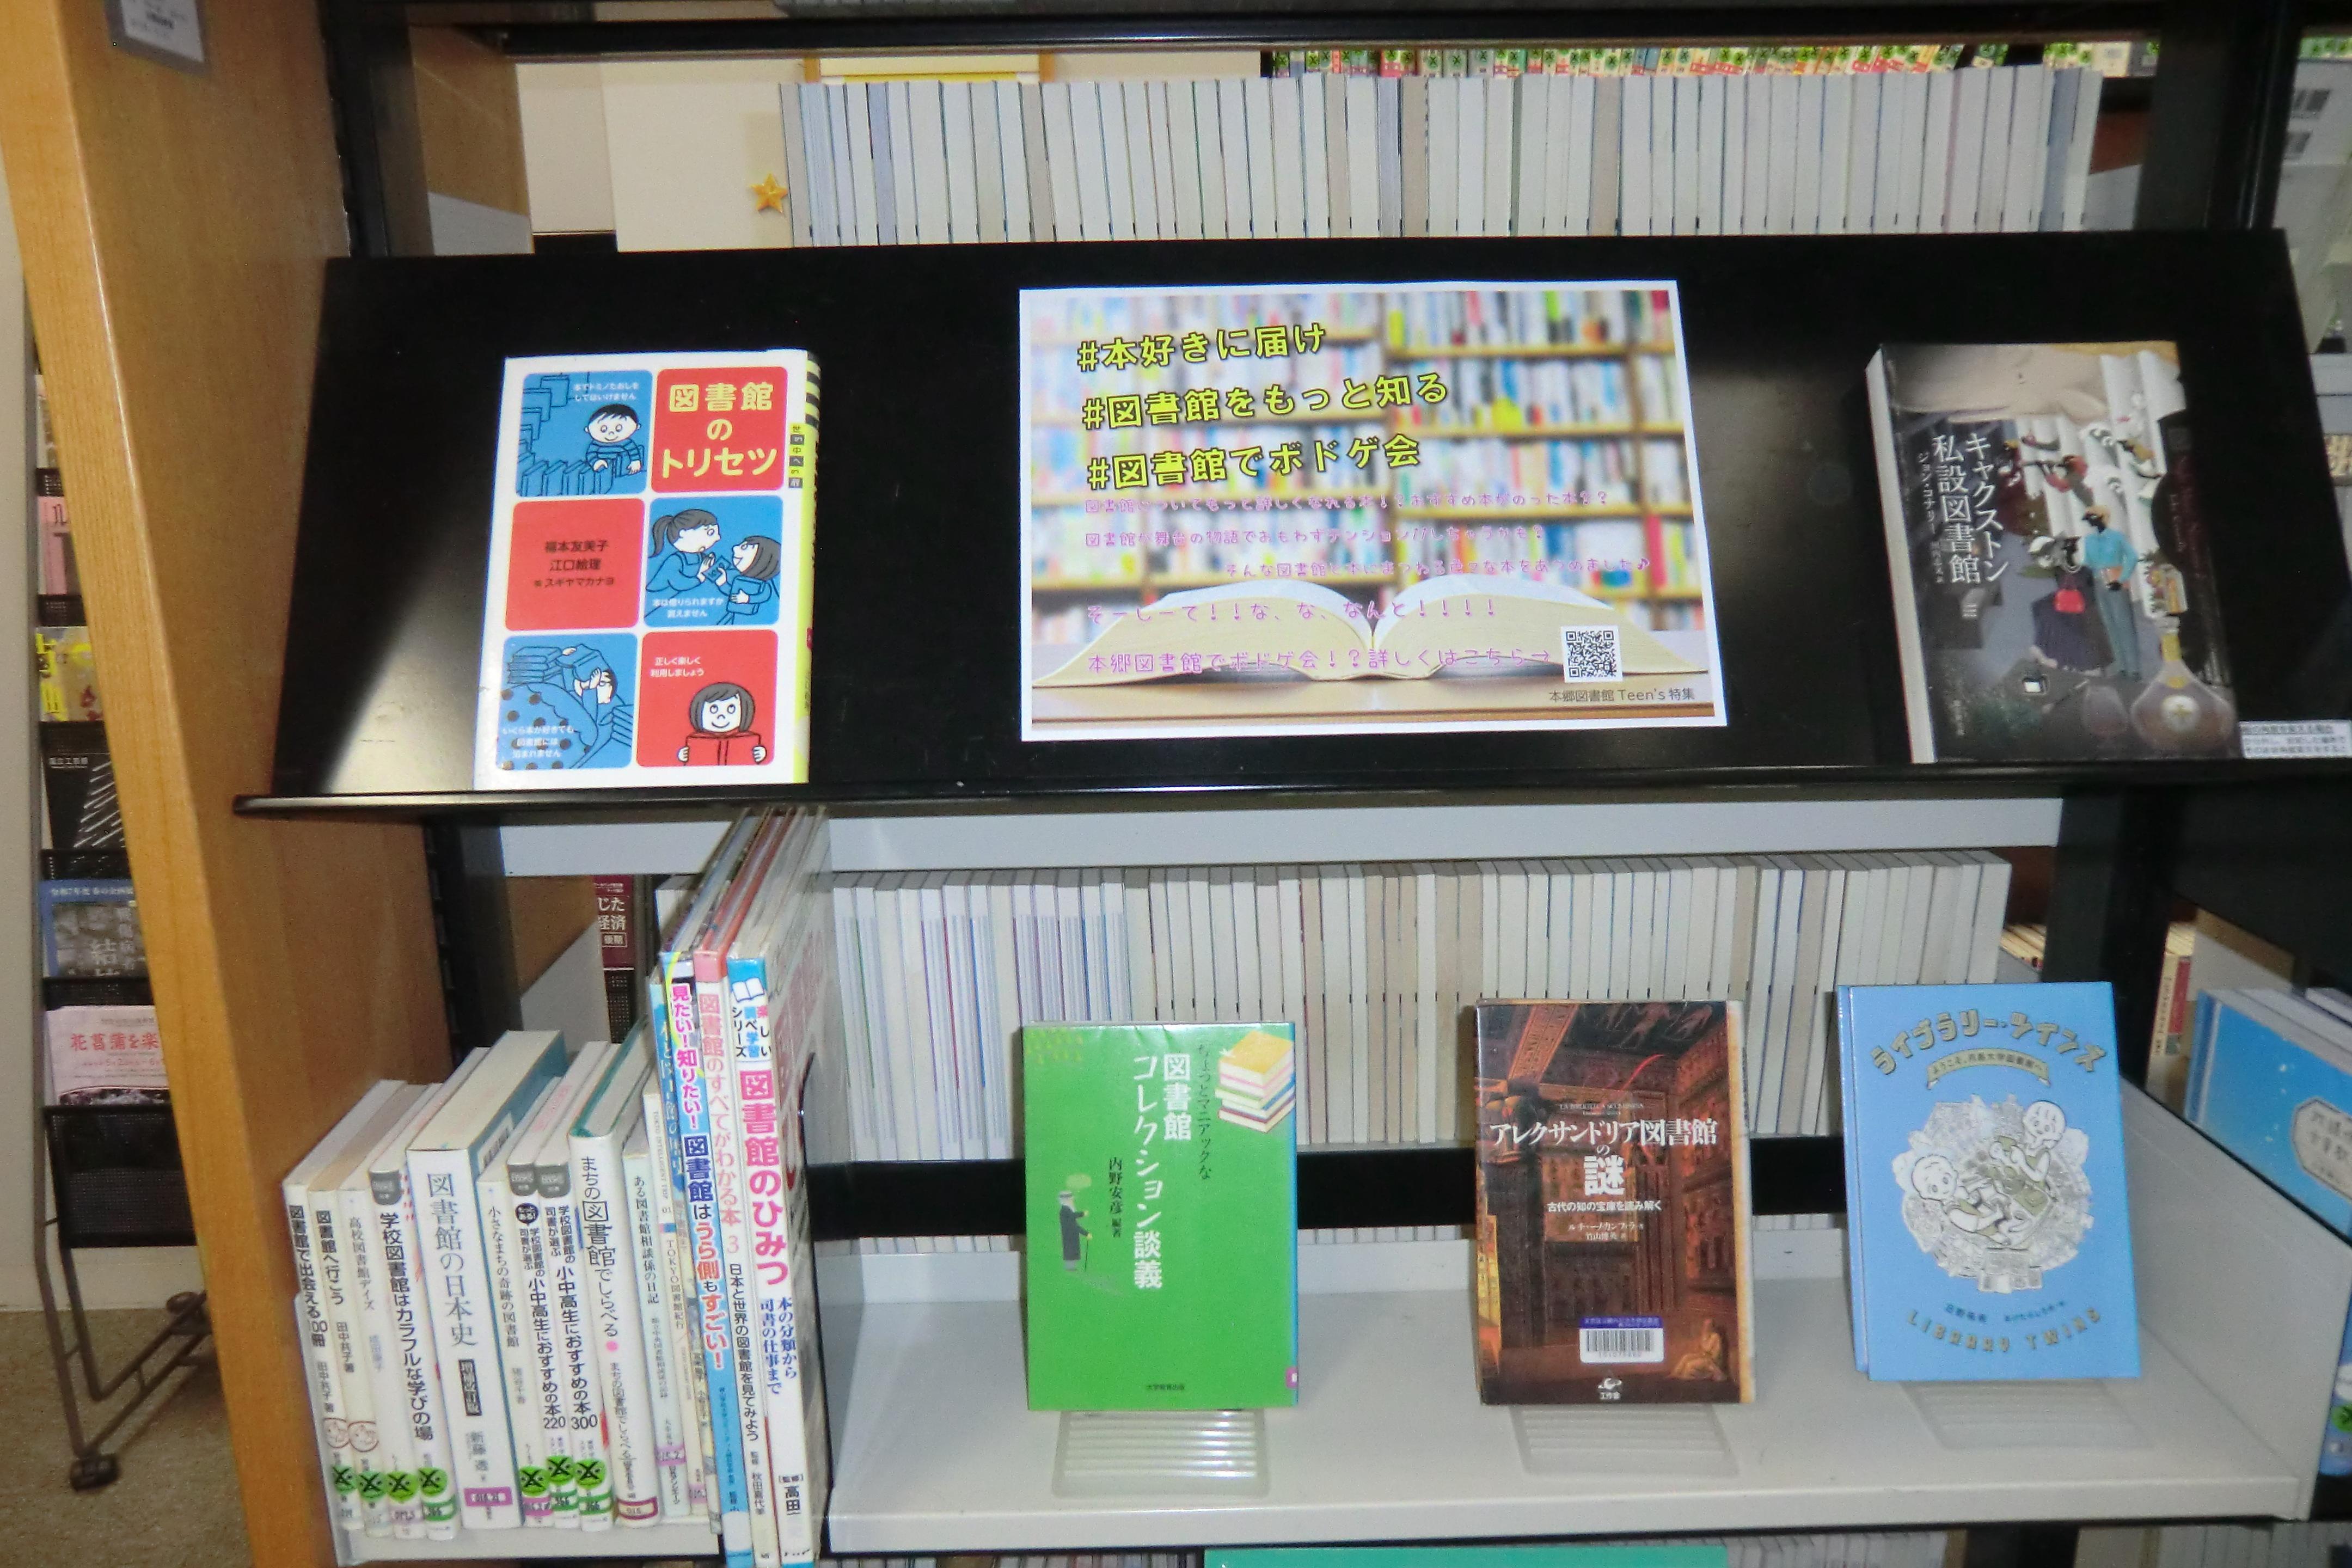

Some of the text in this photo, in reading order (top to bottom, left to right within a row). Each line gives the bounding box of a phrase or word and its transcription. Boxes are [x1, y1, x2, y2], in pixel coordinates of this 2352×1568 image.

[1077, 323, 1325, 372] #本好きに届け
[668, 381, 774, 413] 図書館
[707, 419, 733, 439] の
[1082, 372, 1447, 430] #図書館をもっと知る
[662, 446, 777, 478] トリセツ
[1087, 433, 1419, 489] #図書館でボドゲ会
[1931, 434, 1981, 584] 私設図書館
[1965, 432, 2008, 582] キャクストン
[1549, 689, 1614, 703] 本郷図書館
[1669, 688, 1695, 701] 特集
[699, 994, 741, 1226] 図書館のすべてがわかる本
[1163, 1054, 1191, 1141] 図書館
[1489, 1117, 1718, 1147] アレクサンドリア図書館
[740, 1069, 788, 1285] 図書館のひみつ
[1133, 1055, 1163, 1289] コレクション談義
[1584, 1155, 1625, 1196] 謎
[1596, 1144, 1610, 1155] の
[427, 1173, 478, 1347] 図書館の日本史
[581, 1156, 618, 1337] まちの図書館でしらべる
[729, 1263, 758, 1441] 日本と世界の図書館を見てみよう
[760, 1300, 782, 1394] 司書の仕事まで
[777, 1296, 798, 1379] 本の分類から
